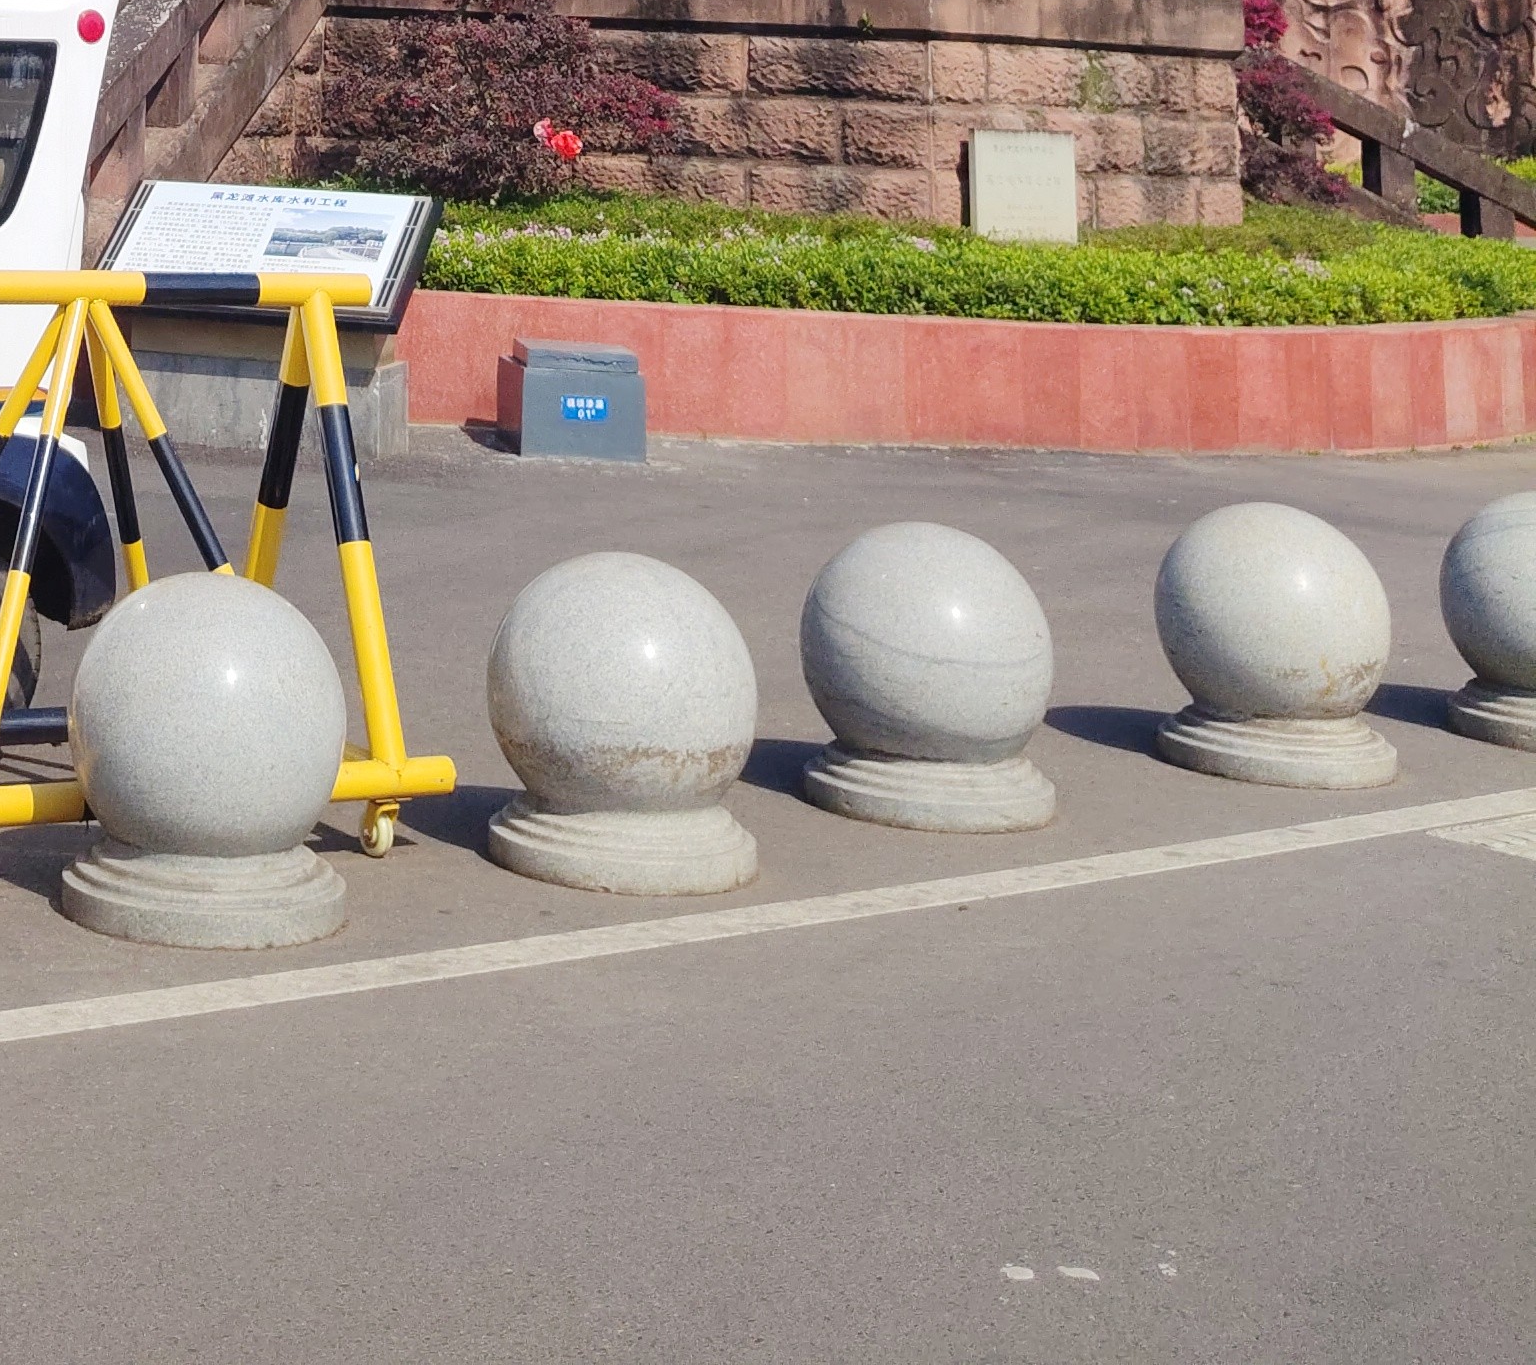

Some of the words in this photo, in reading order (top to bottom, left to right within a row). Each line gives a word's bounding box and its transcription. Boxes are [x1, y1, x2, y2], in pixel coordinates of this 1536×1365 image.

[210, 191, 348, 207] 黑龙滩水库水利工程
